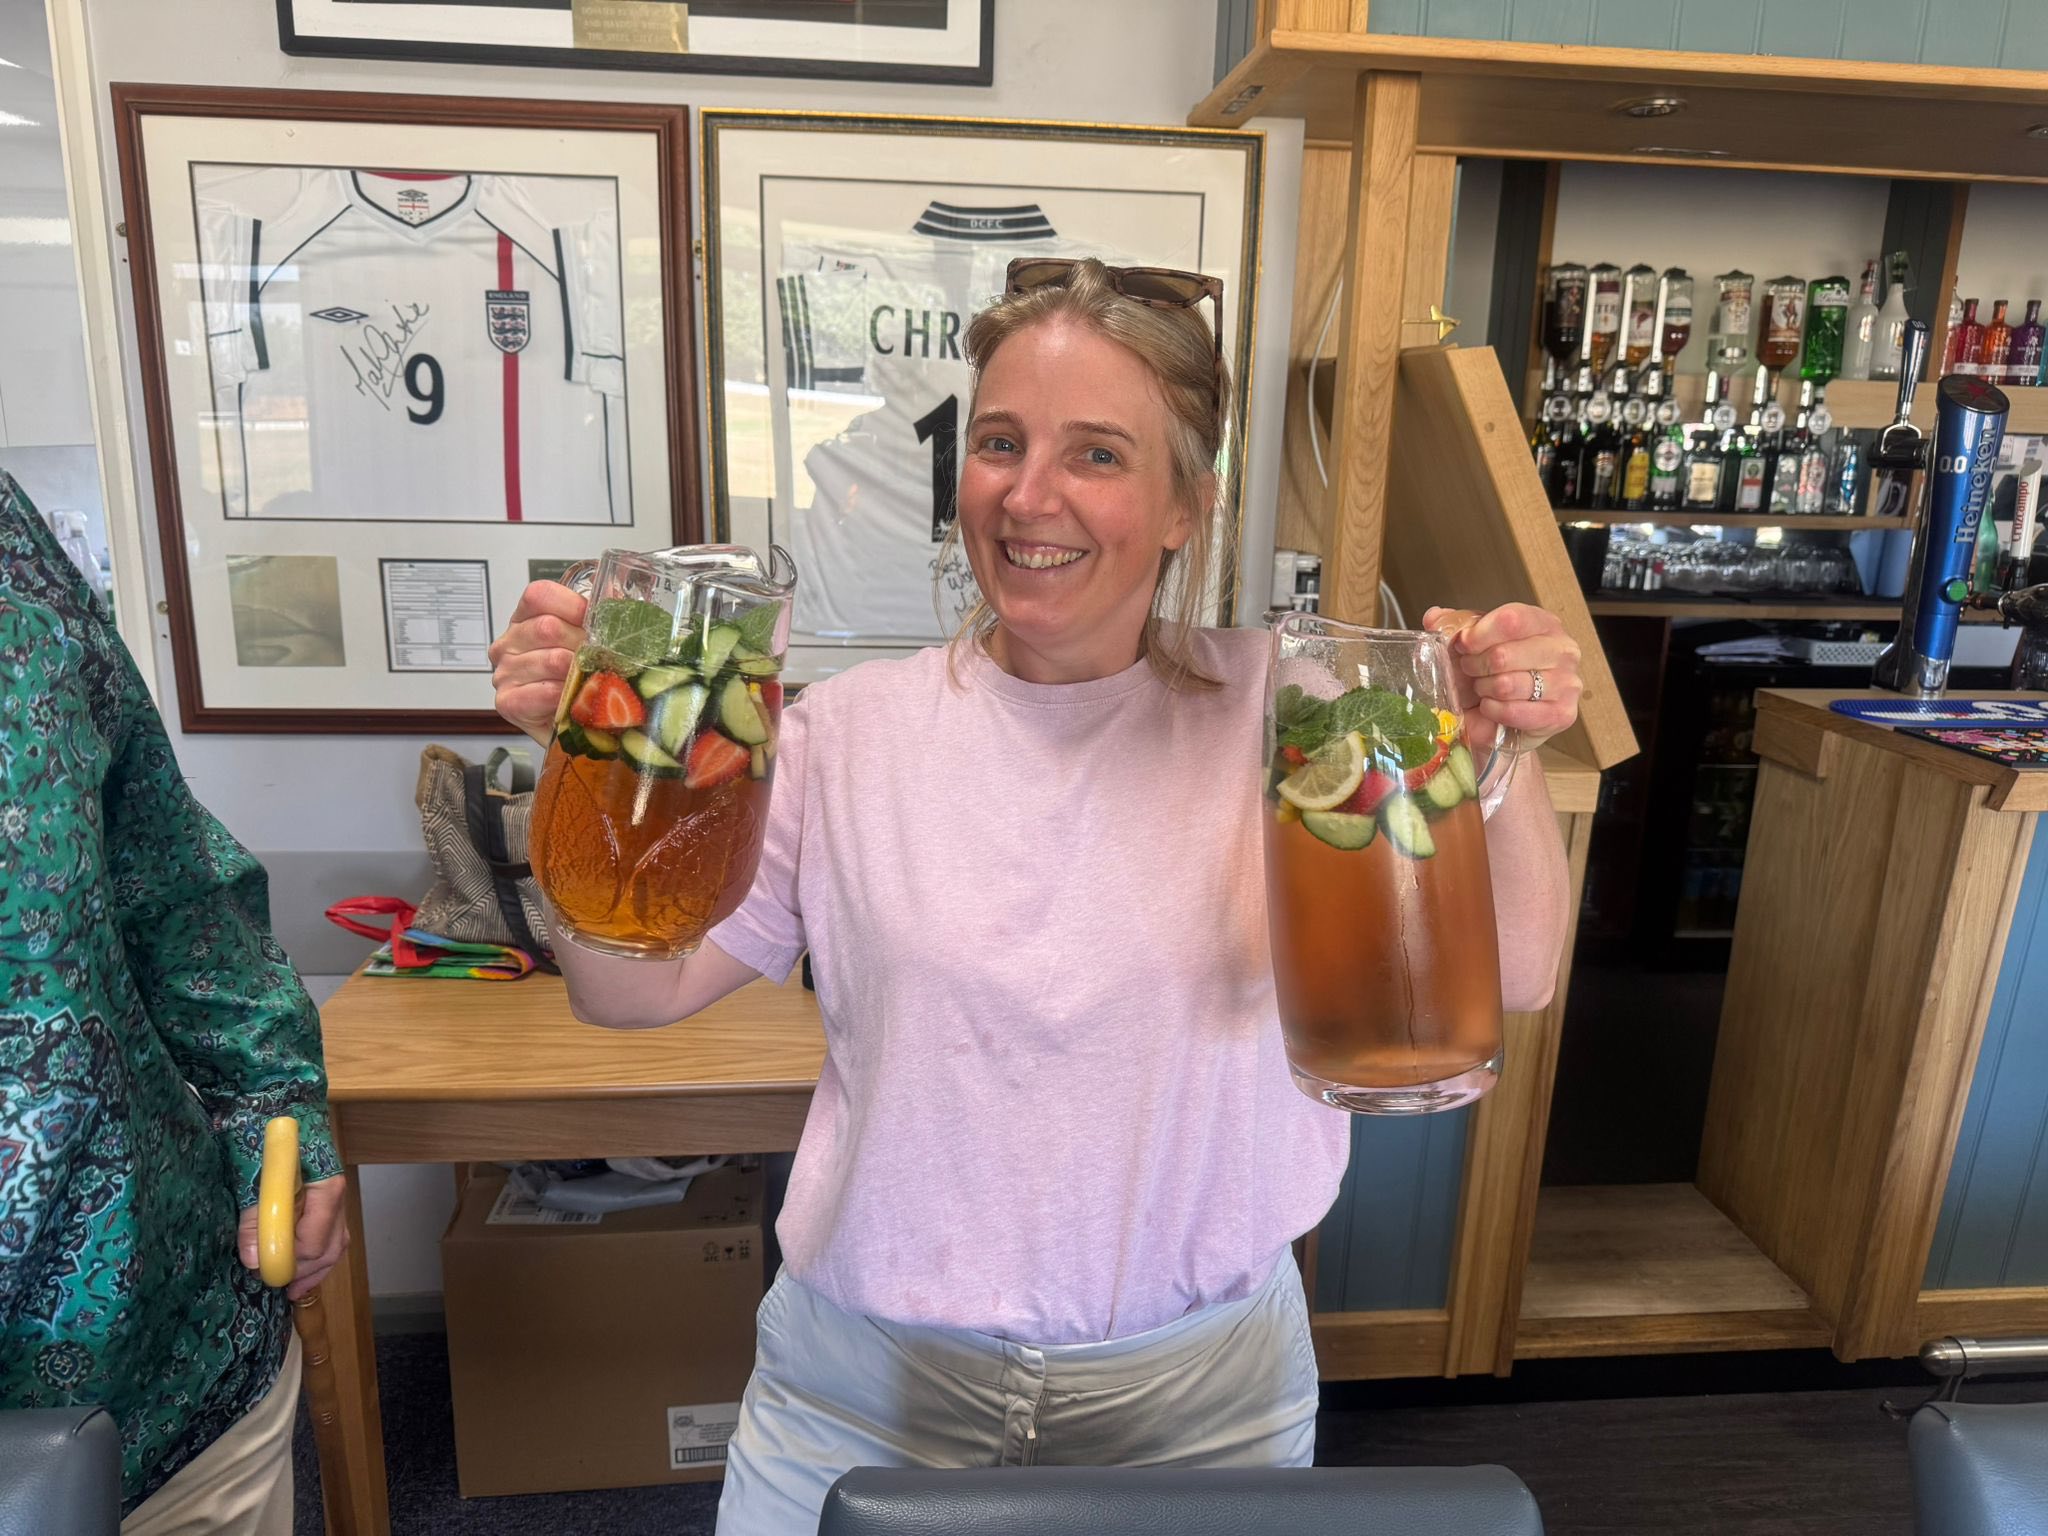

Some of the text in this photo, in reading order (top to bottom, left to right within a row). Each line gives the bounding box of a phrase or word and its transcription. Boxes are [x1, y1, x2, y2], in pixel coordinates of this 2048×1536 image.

[969, 218, 1003, 230] DCFC
[488, 292, 527, 300] ENGLAND
[869, 304, 962, 361] CHR
[403, 353, 445, 426] 9
[1939, 455, 1968, 474] 0.0
[1953, 427, 1997, 545] Heineken
